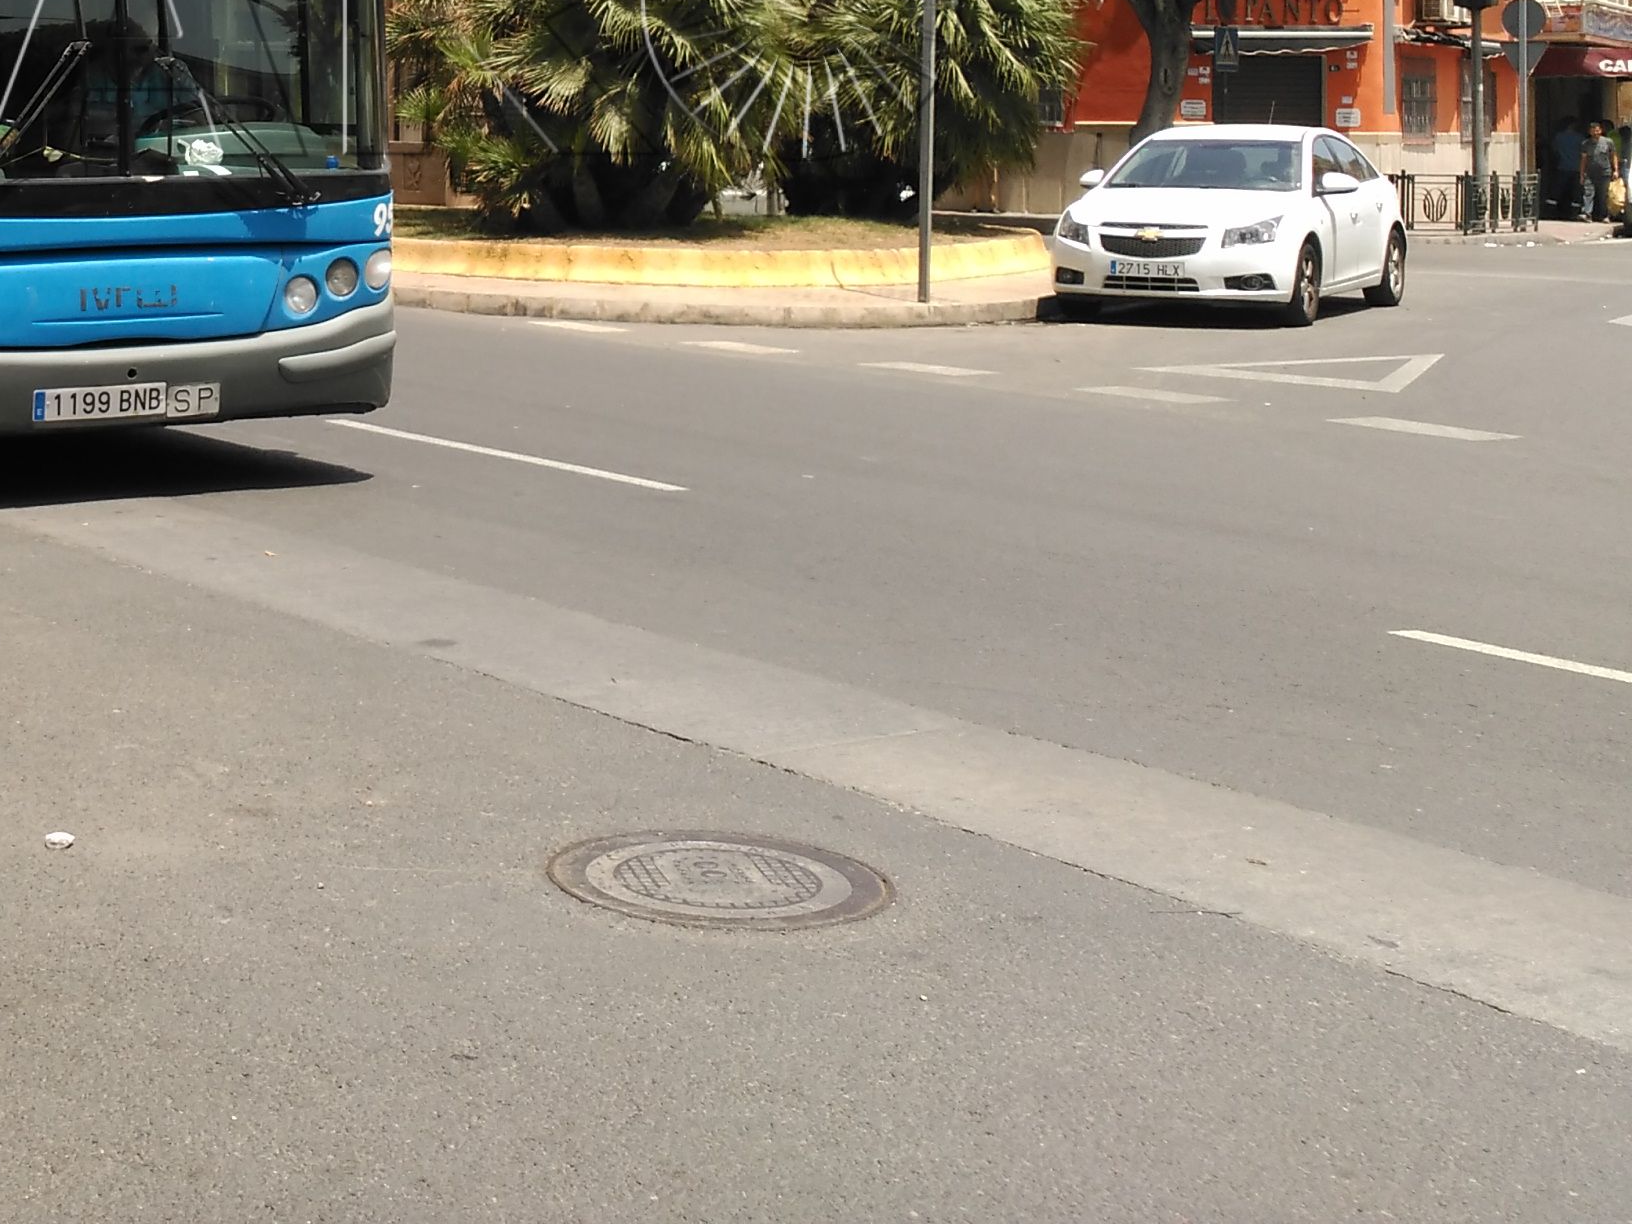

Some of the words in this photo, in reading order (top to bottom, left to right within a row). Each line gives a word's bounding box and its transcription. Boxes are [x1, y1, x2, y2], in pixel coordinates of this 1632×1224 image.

[1118, 262, 1151, 275] 2715
[1157, 264, 1180, 277] HLX
[54, 391, 111, 417] 1199
[119, 387, 161, 413] BNB
